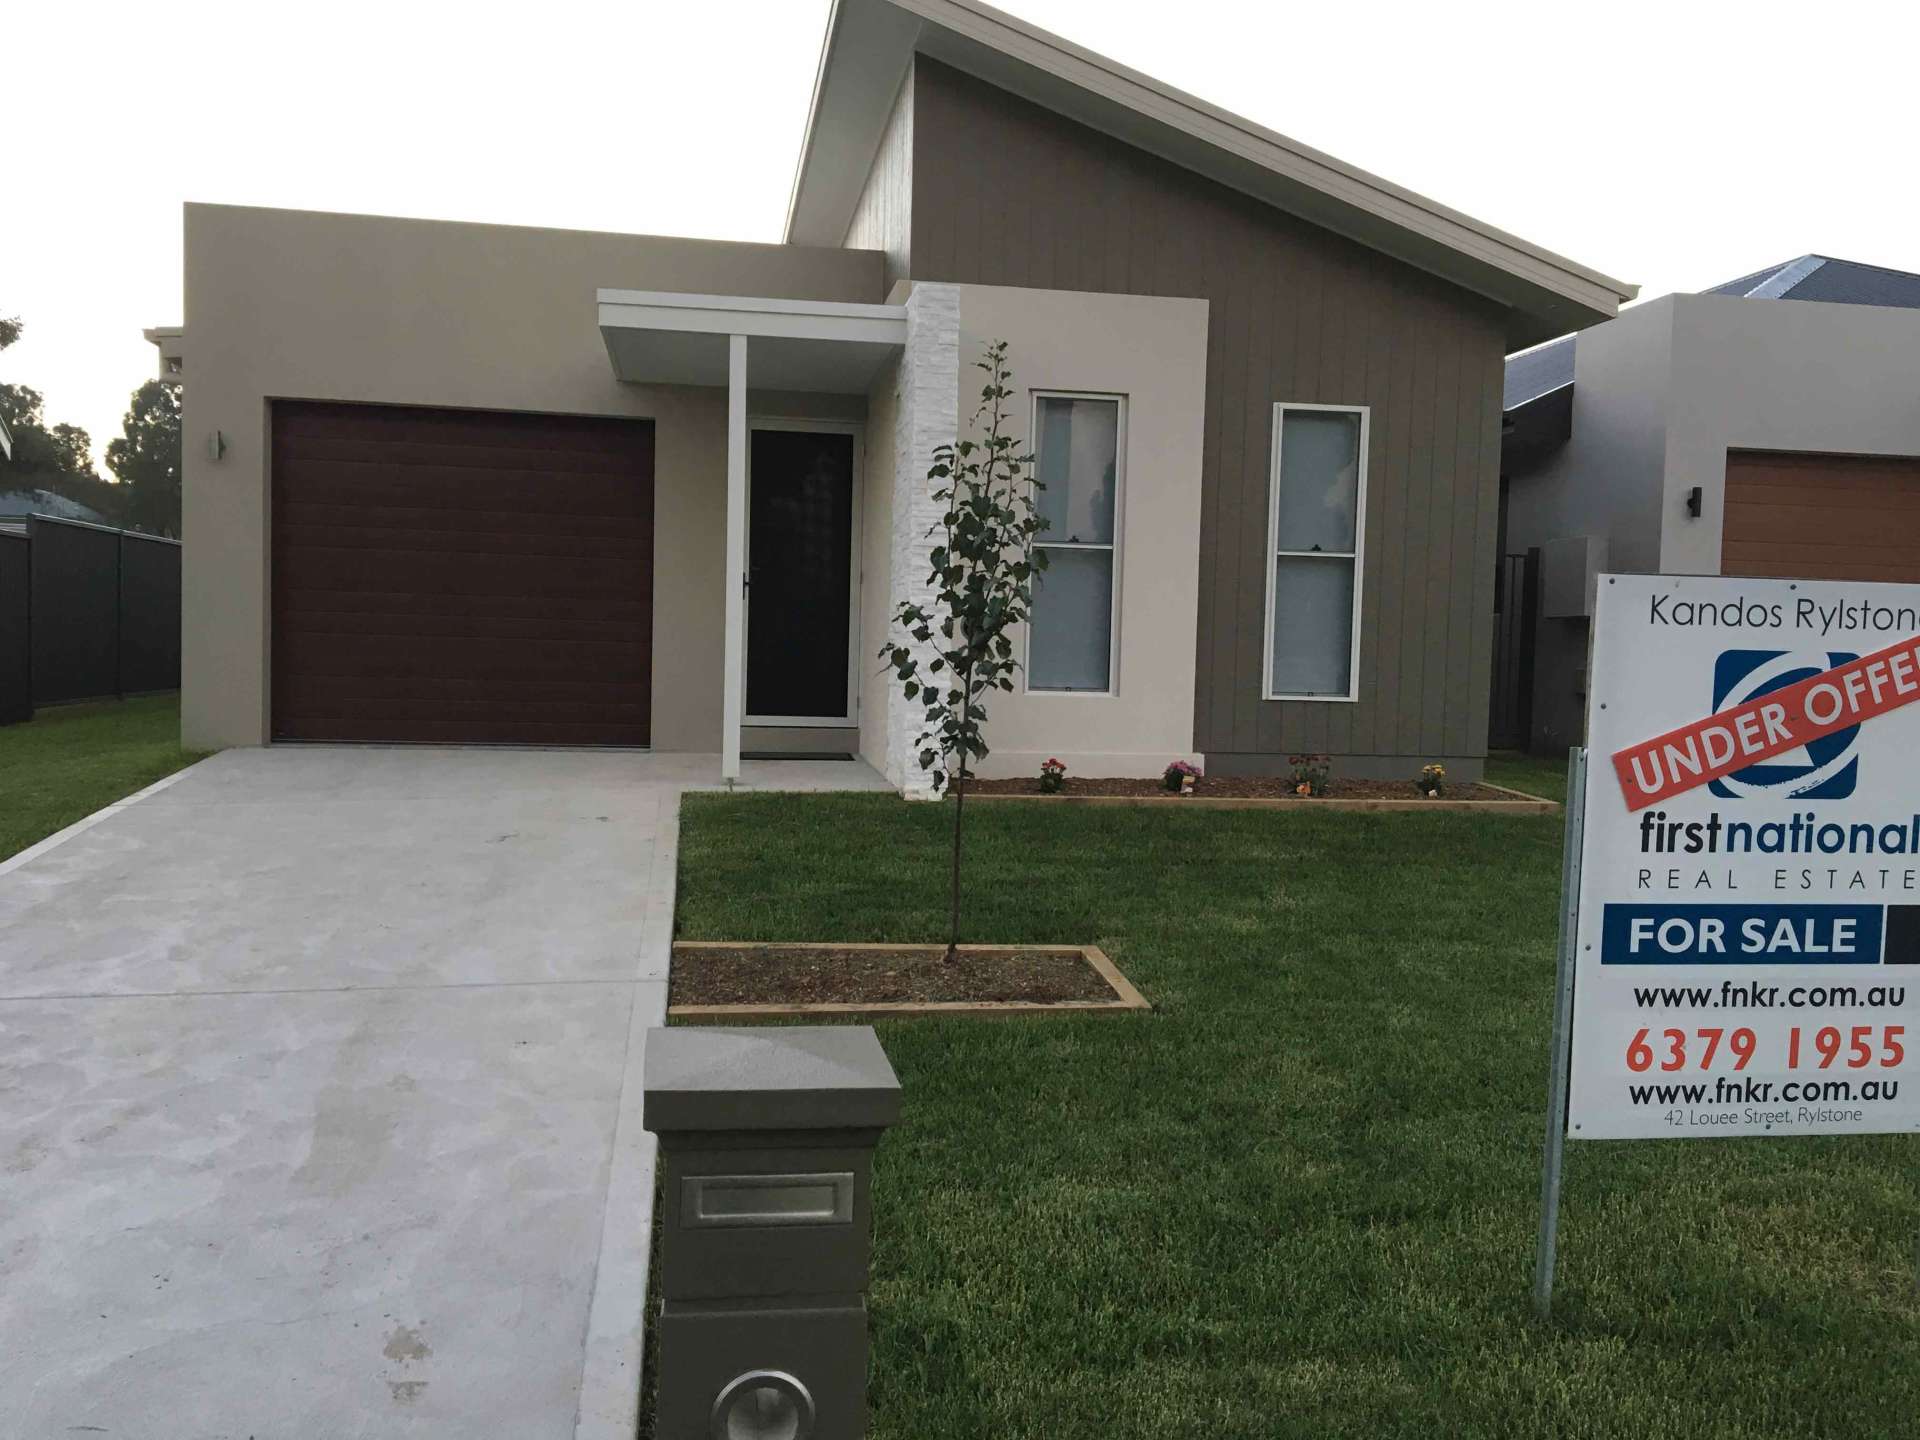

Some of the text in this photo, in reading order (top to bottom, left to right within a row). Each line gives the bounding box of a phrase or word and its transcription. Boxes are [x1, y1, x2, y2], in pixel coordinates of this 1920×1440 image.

[1650, 594, 1920, 636] Kandos Rylston
[1631, 646, 1920, 795] UNDER OFFE
[1638, 869, 1916, 889] REAL ESTATE
[1629, 918, 1857, 953] FOR SALE
[1634, 981, 1905, 1008] www.fnkr.com.au
[1626, 1026, 1905, 1072] 6379 1955
[1629, 1077, 1898, 1105] www.fnkr.com.au
[1664, 1105, 1863, 1127] 42 Louee Street, Rylstone
